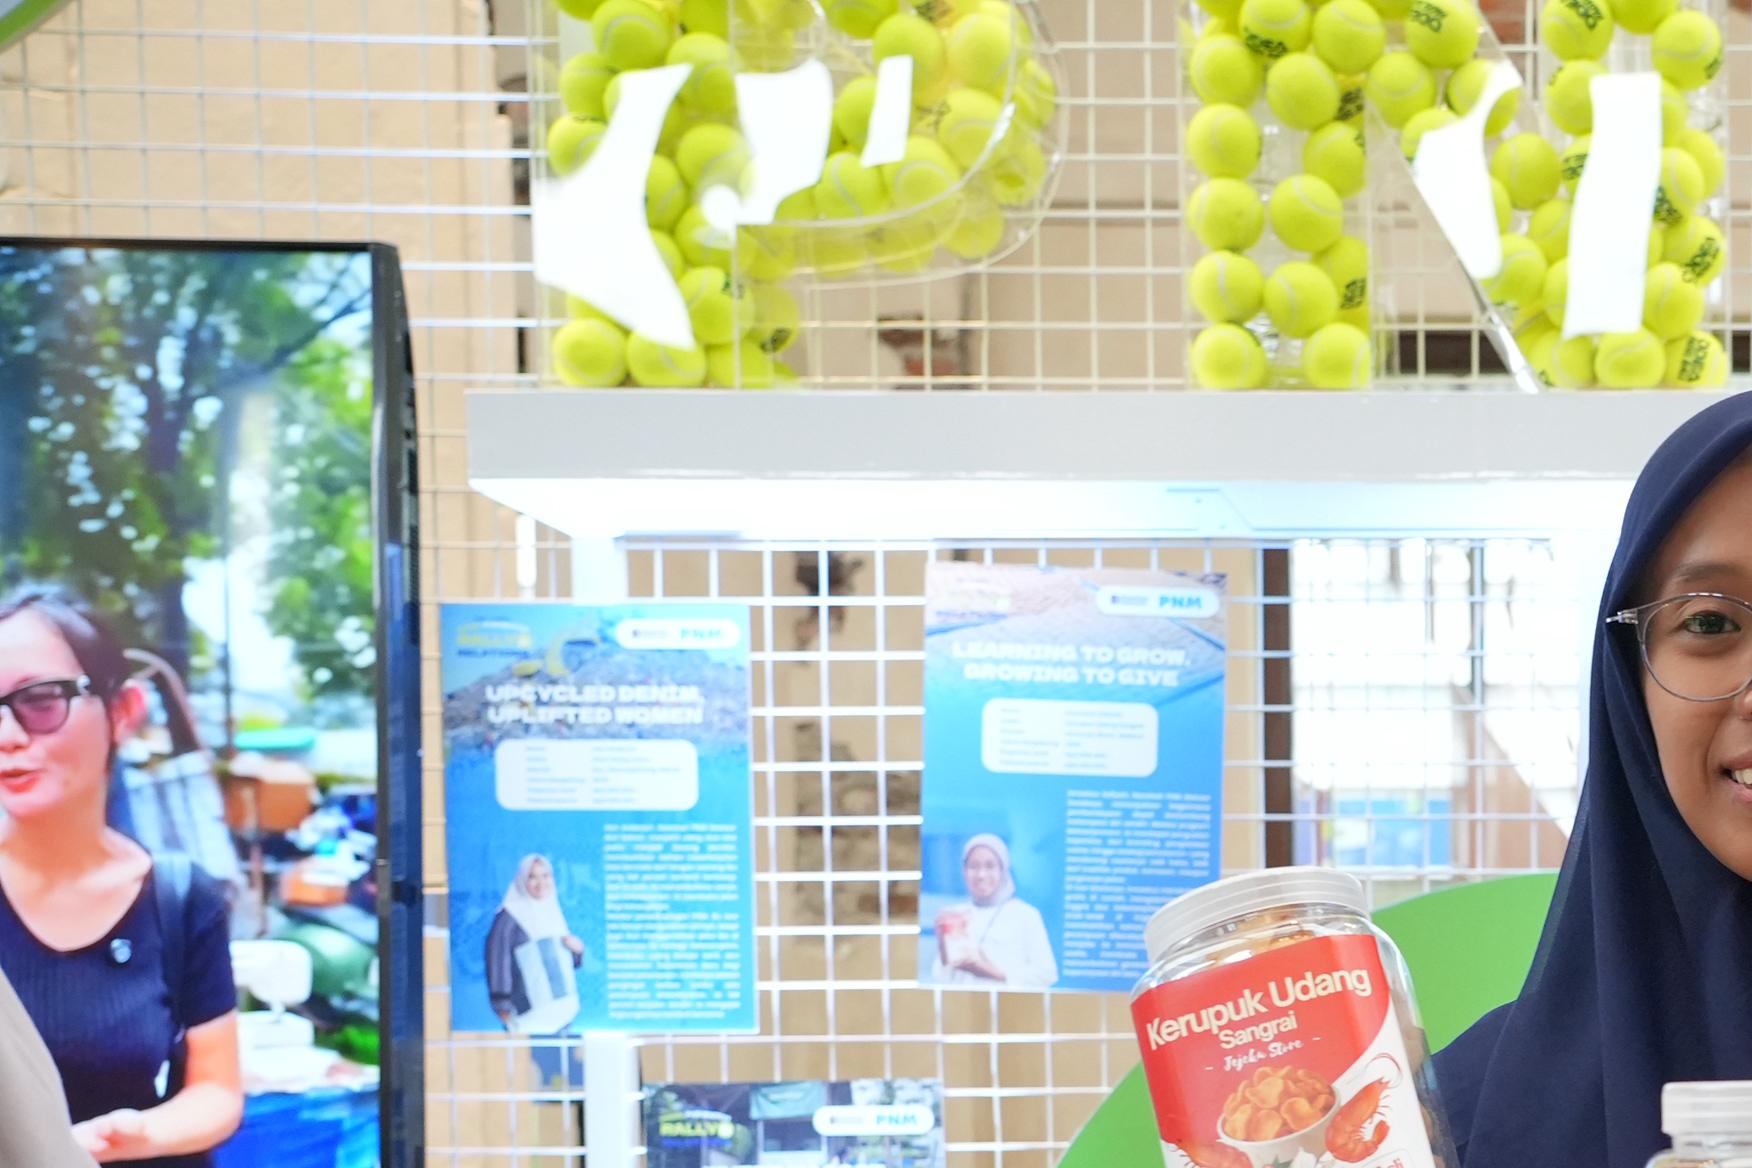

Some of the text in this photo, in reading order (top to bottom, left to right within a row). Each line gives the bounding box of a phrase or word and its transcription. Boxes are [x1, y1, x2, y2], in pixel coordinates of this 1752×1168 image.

[952, 641, 1078, 661] LEARNING
[1080, 645, 1114, 665] TO
[964, 664, 1179, 687] GROWING TO GIVE
[485, 684, 616, 702] UPCYCLED
[487, 705, 613, 725] UPLIFTED
[1146, 967, 1373, 1051] Kerupuk Udang
[1218, 1010, 1299, 1050] Sangrai
